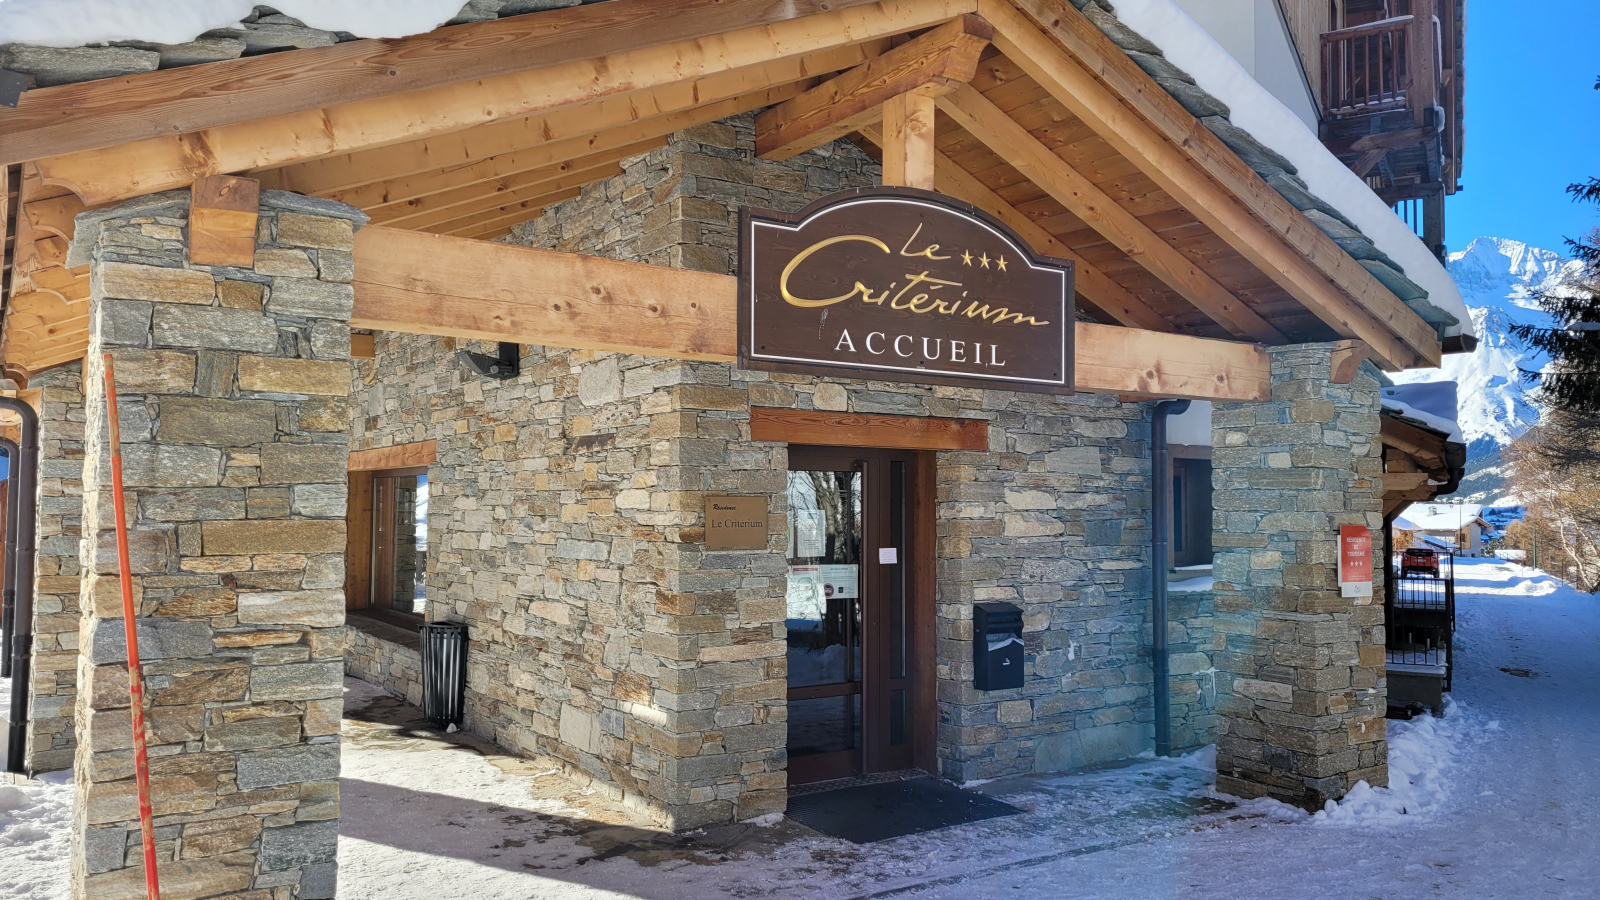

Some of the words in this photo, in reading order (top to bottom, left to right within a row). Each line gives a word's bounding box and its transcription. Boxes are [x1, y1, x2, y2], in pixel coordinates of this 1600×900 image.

[900, 222, 952, 260] Le
[780, 234, 1050, 326] Critérium
[834, 328, 1006, 367] ACCUEIL
[711, 519, 723, 528] Le
[724, 518, 763, 528] Critérium
